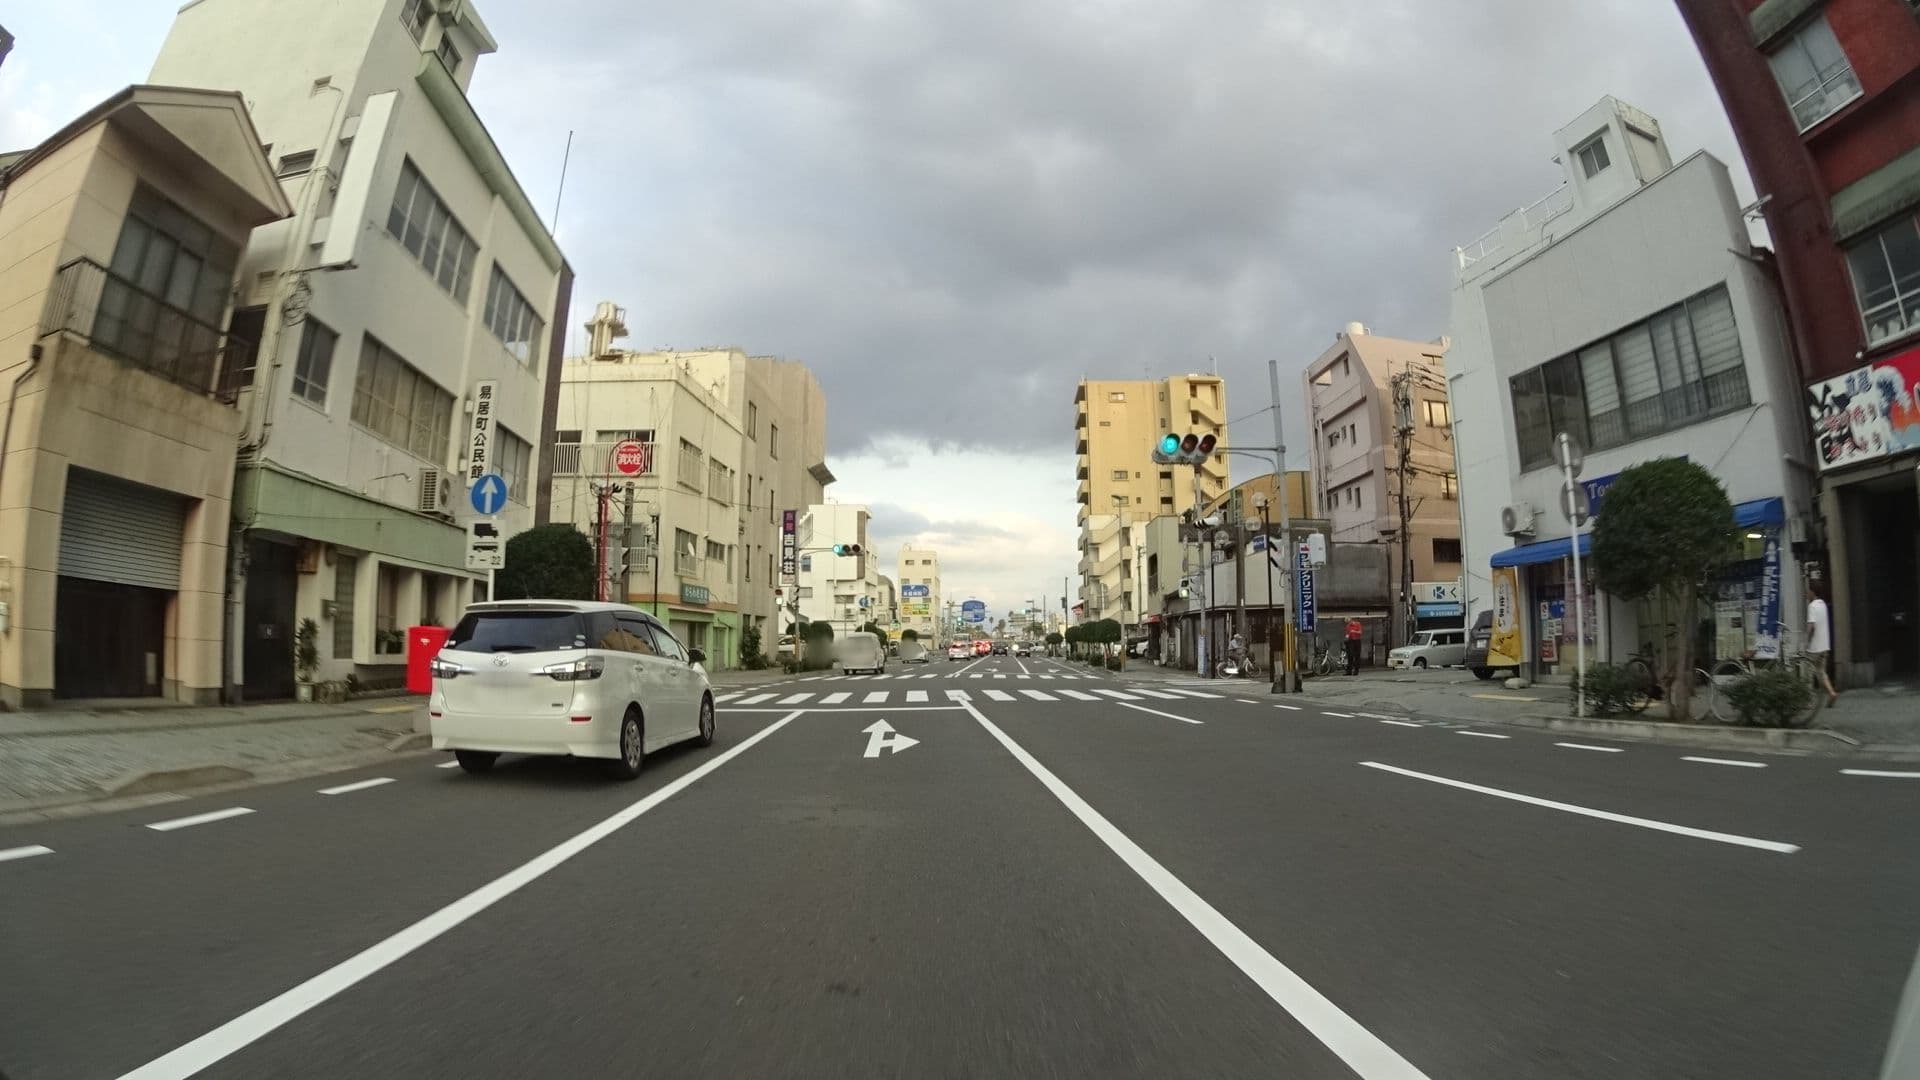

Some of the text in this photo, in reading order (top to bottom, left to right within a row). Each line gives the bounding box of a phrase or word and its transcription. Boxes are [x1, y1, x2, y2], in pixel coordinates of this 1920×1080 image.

[471, 385, 492, 479] 易居町公民館
[617, 453, 641, 465] 消火栓
